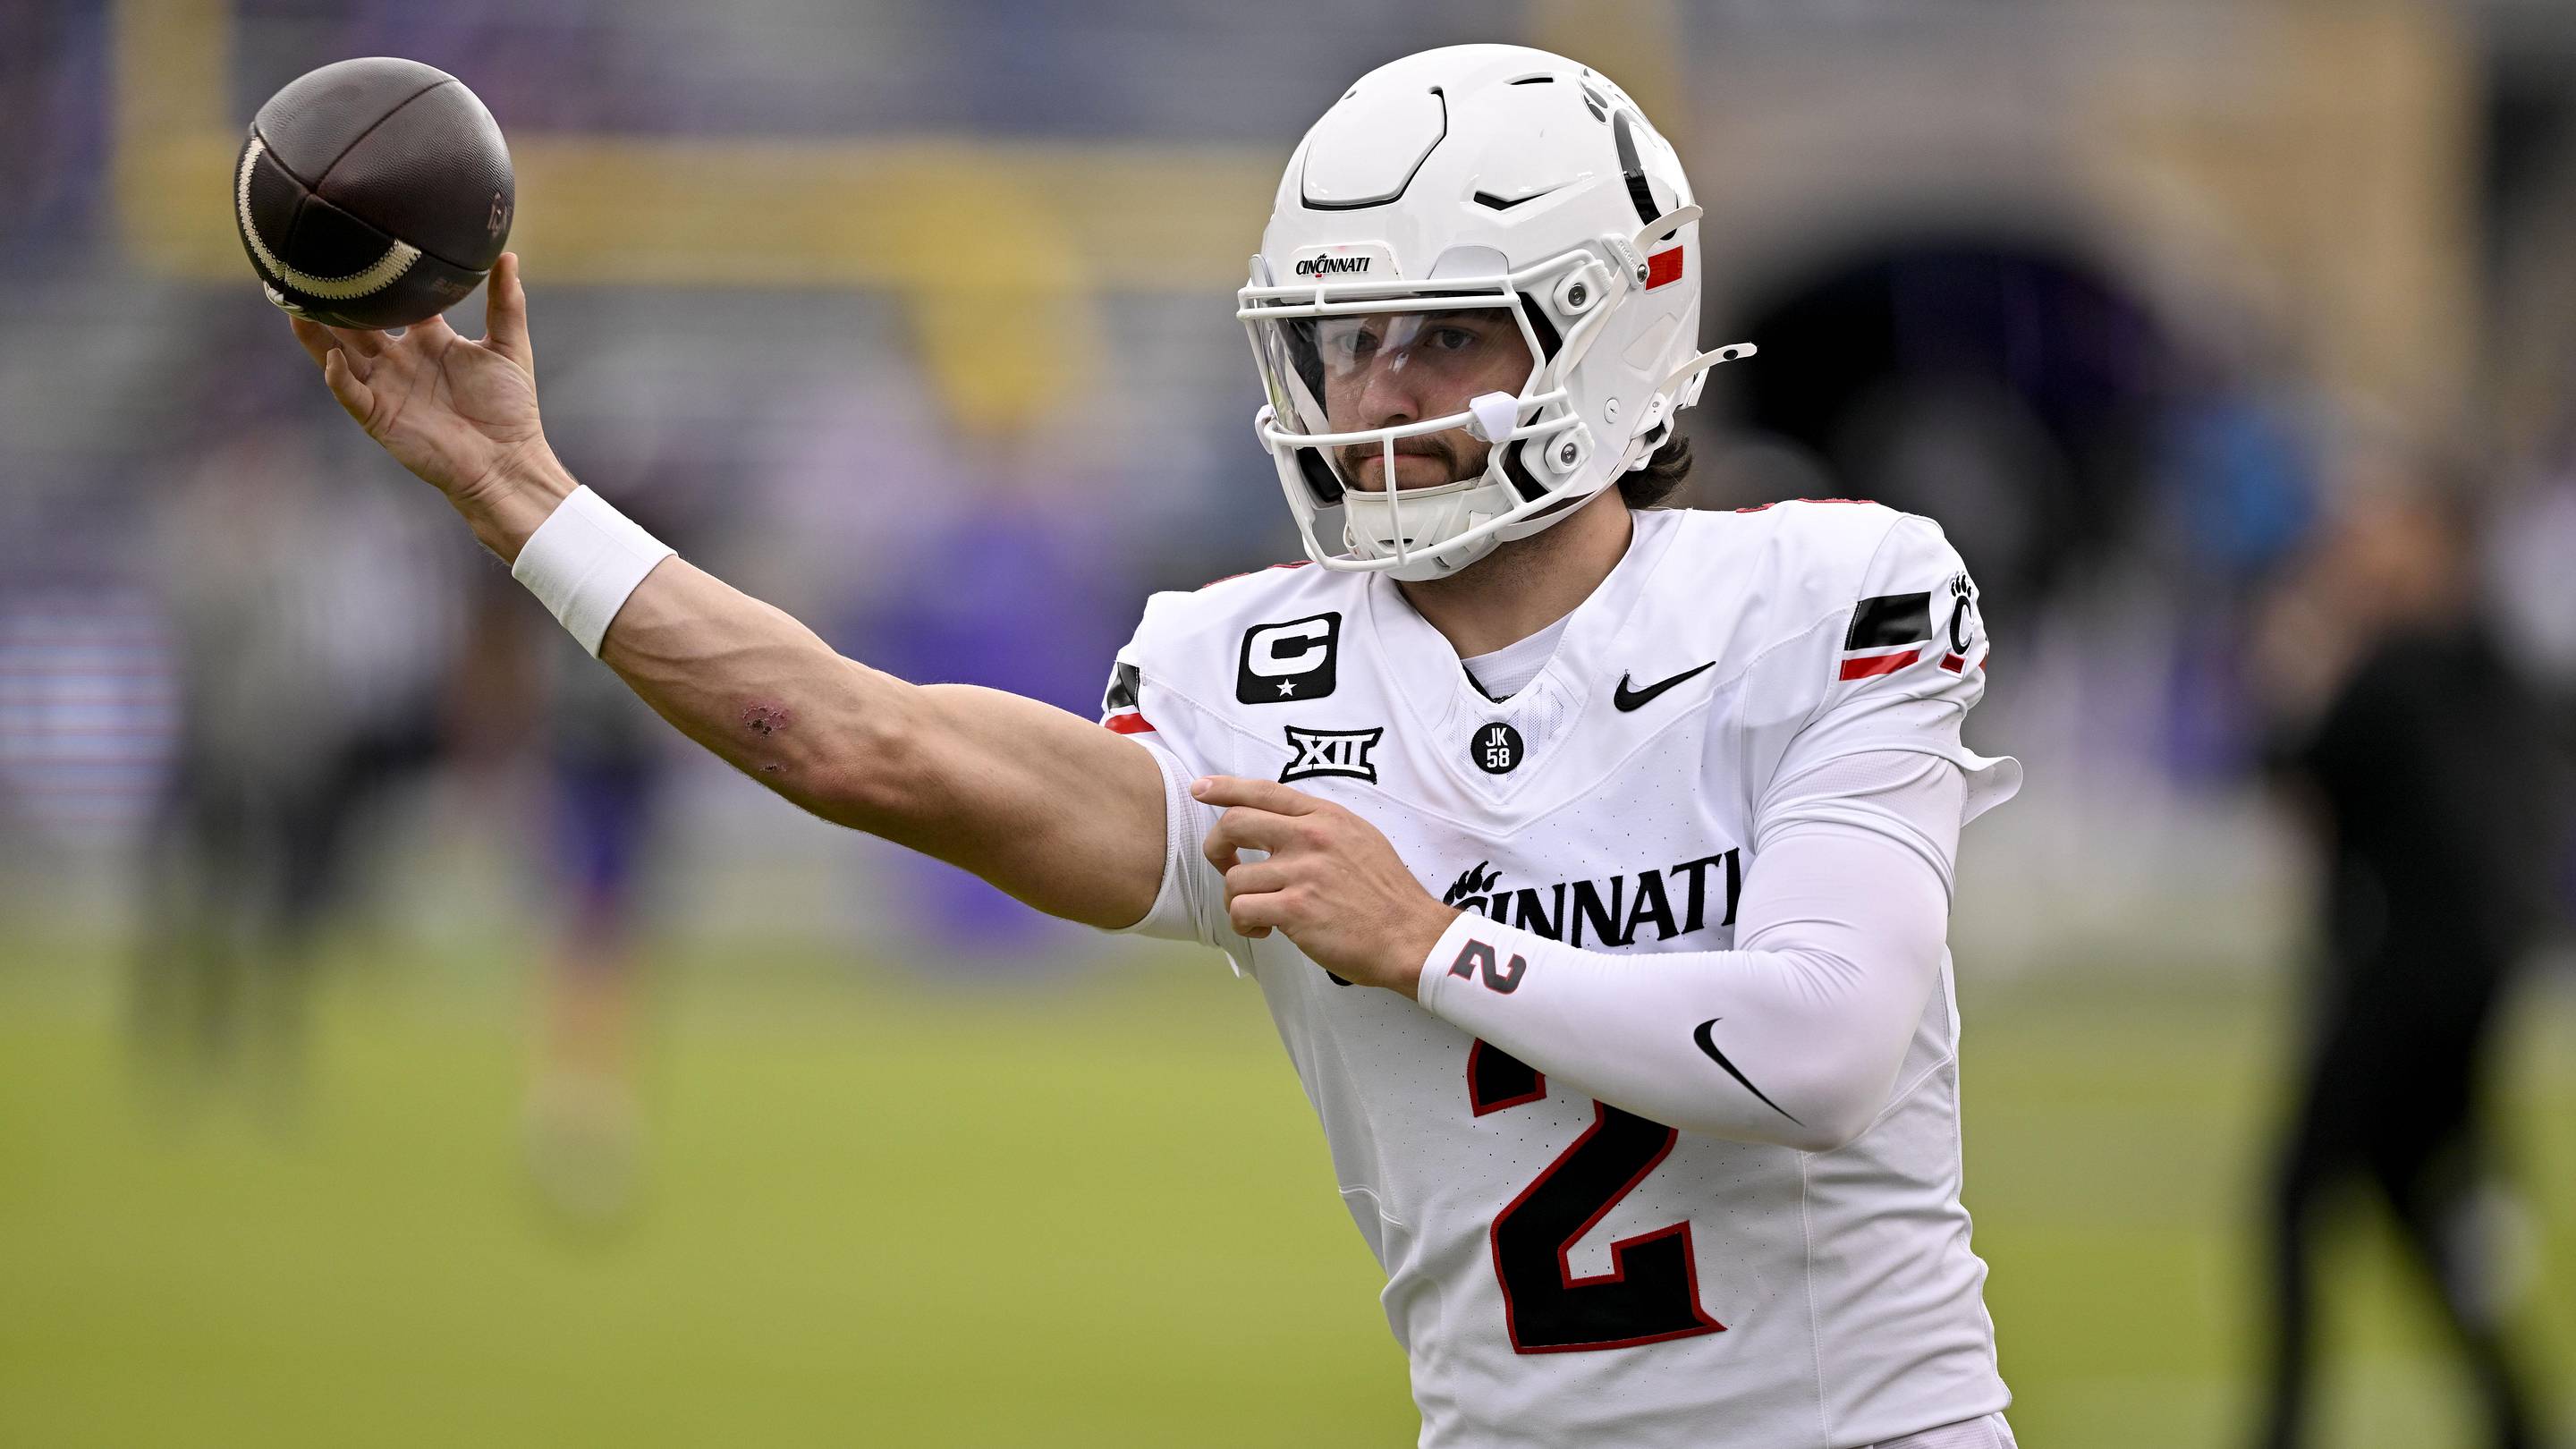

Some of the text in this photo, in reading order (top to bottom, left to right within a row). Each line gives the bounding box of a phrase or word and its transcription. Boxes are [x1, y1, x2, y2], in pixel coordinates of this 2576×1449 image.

[1295, 254, 1370, 275] CINCINNATI
[1248, 618, 1330, 677] C
[1286, 732, 1376, 775] XII
[1485, 727, 1508, 747] JK
[1487, 748, 1510, 768] 58
[1447, 937, 1527, 995] 2
[1467, 1038, 1728, 1355] 2
